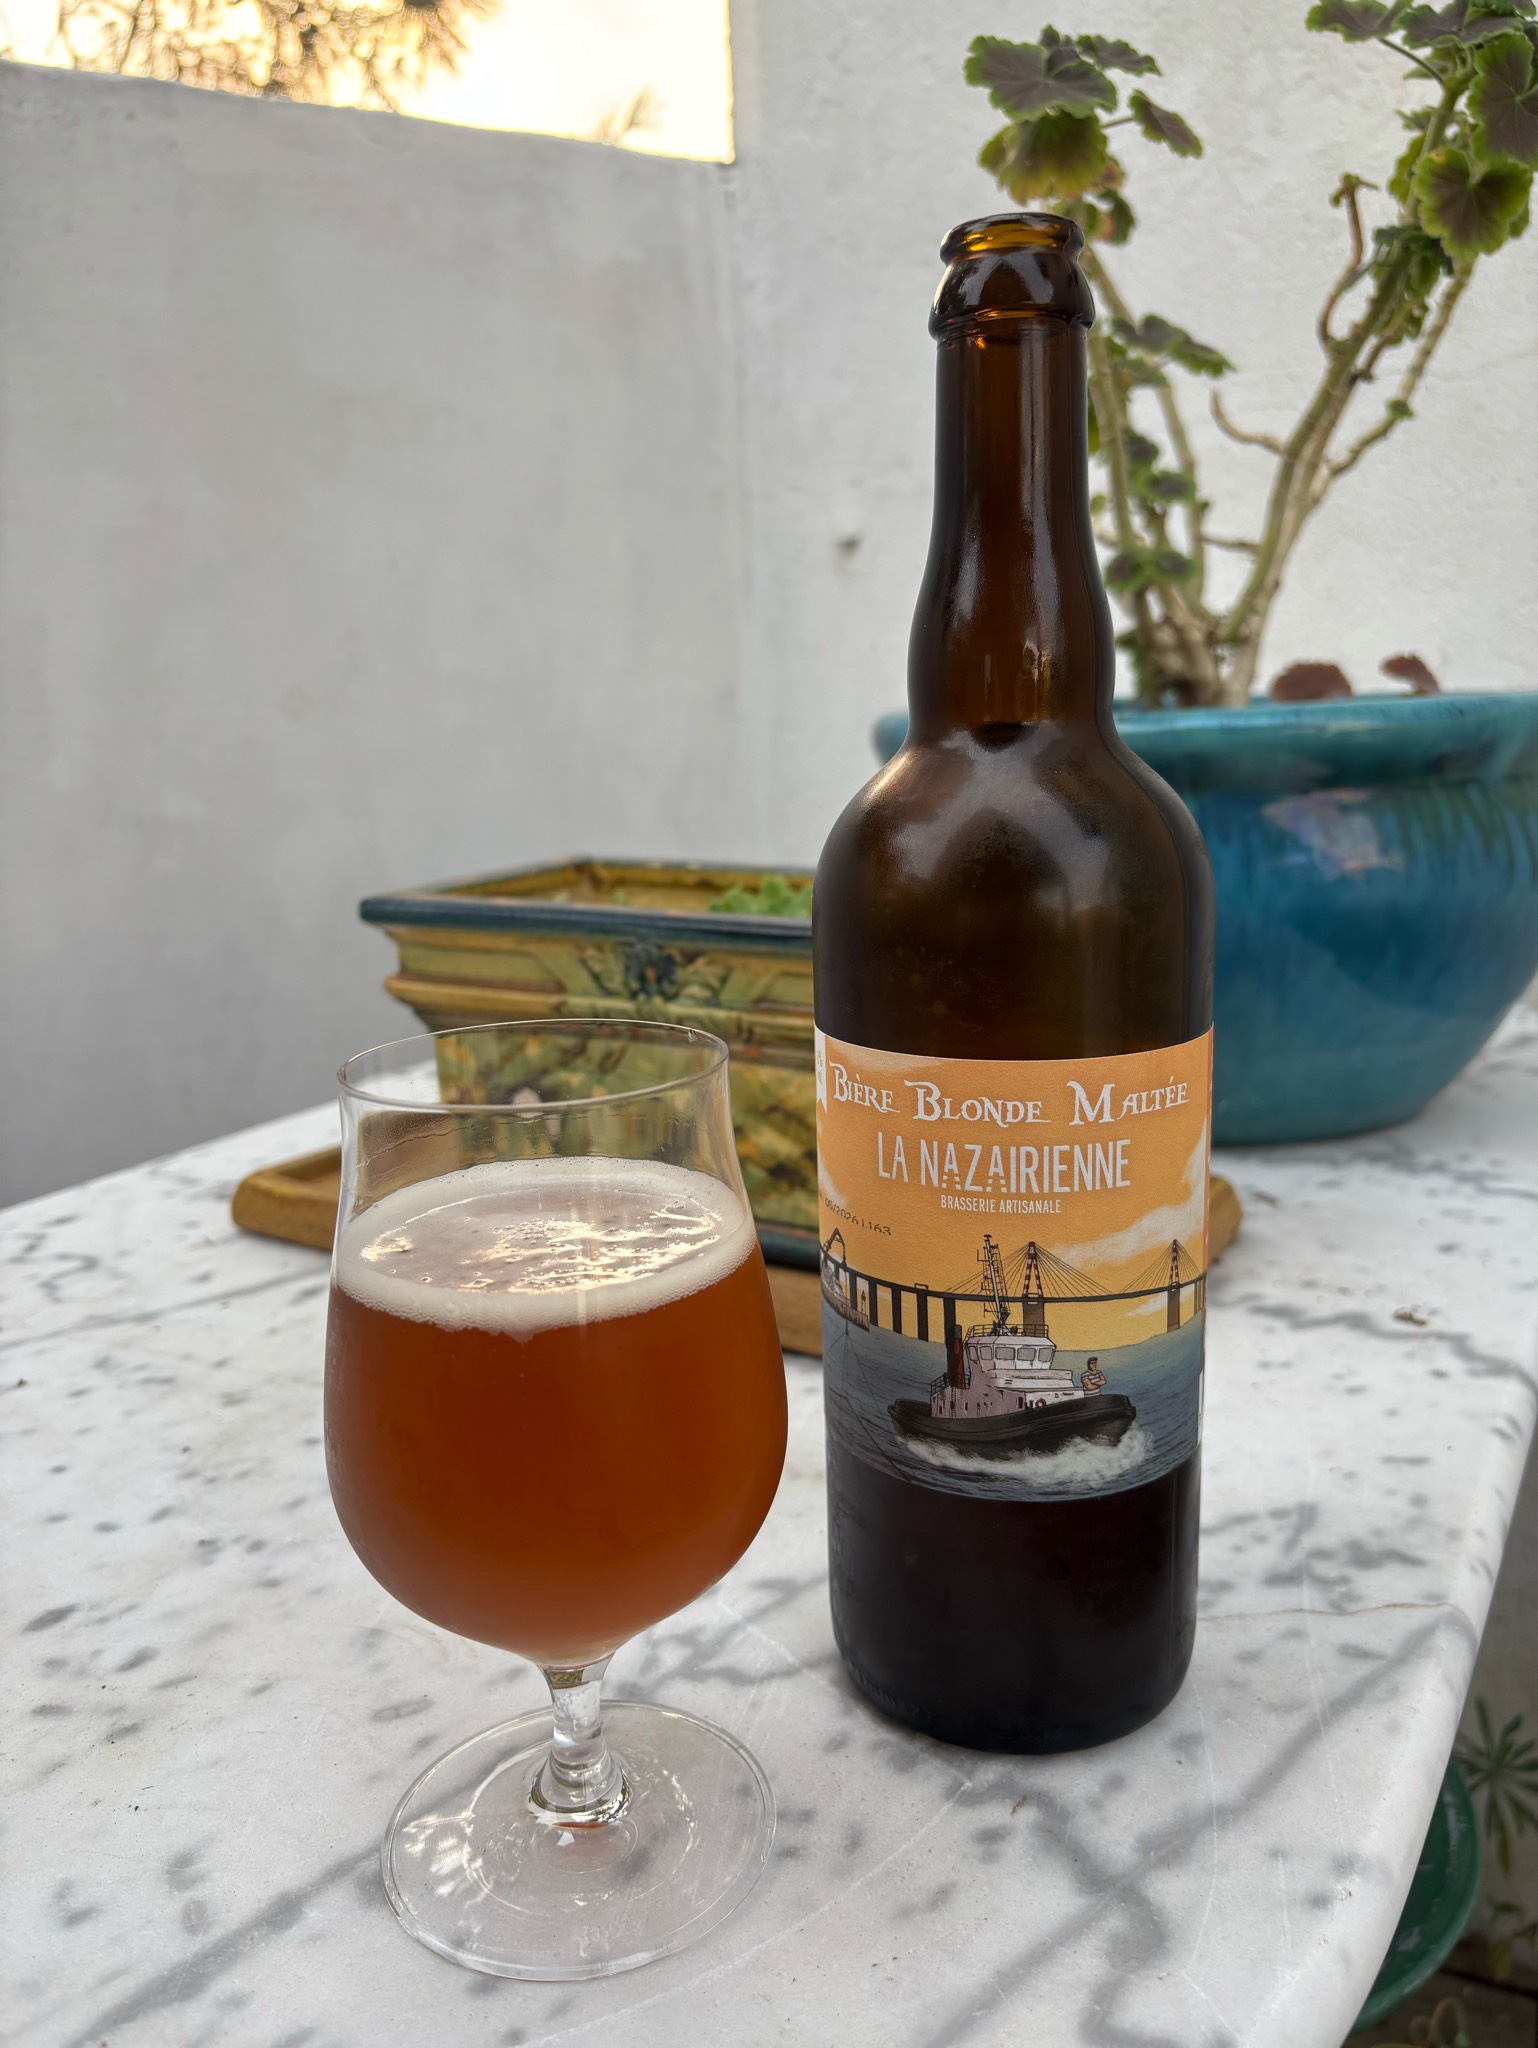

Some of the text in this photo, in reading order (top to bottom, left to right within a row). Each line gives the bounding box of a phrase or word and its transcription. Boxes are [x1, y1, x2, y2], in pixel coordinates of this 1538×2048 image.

[829, 1060, 900, 1113] BIÈRE
[904, 1079, 1051, 1128] BLONDE
[1066, 1075, 1190, 1126] MALTÉE
[877, 1131, 1131, 1194] LA NAZAIRIENNE
[940, 1194, 1062, 1215] BRASSERIE ARTISANALE
